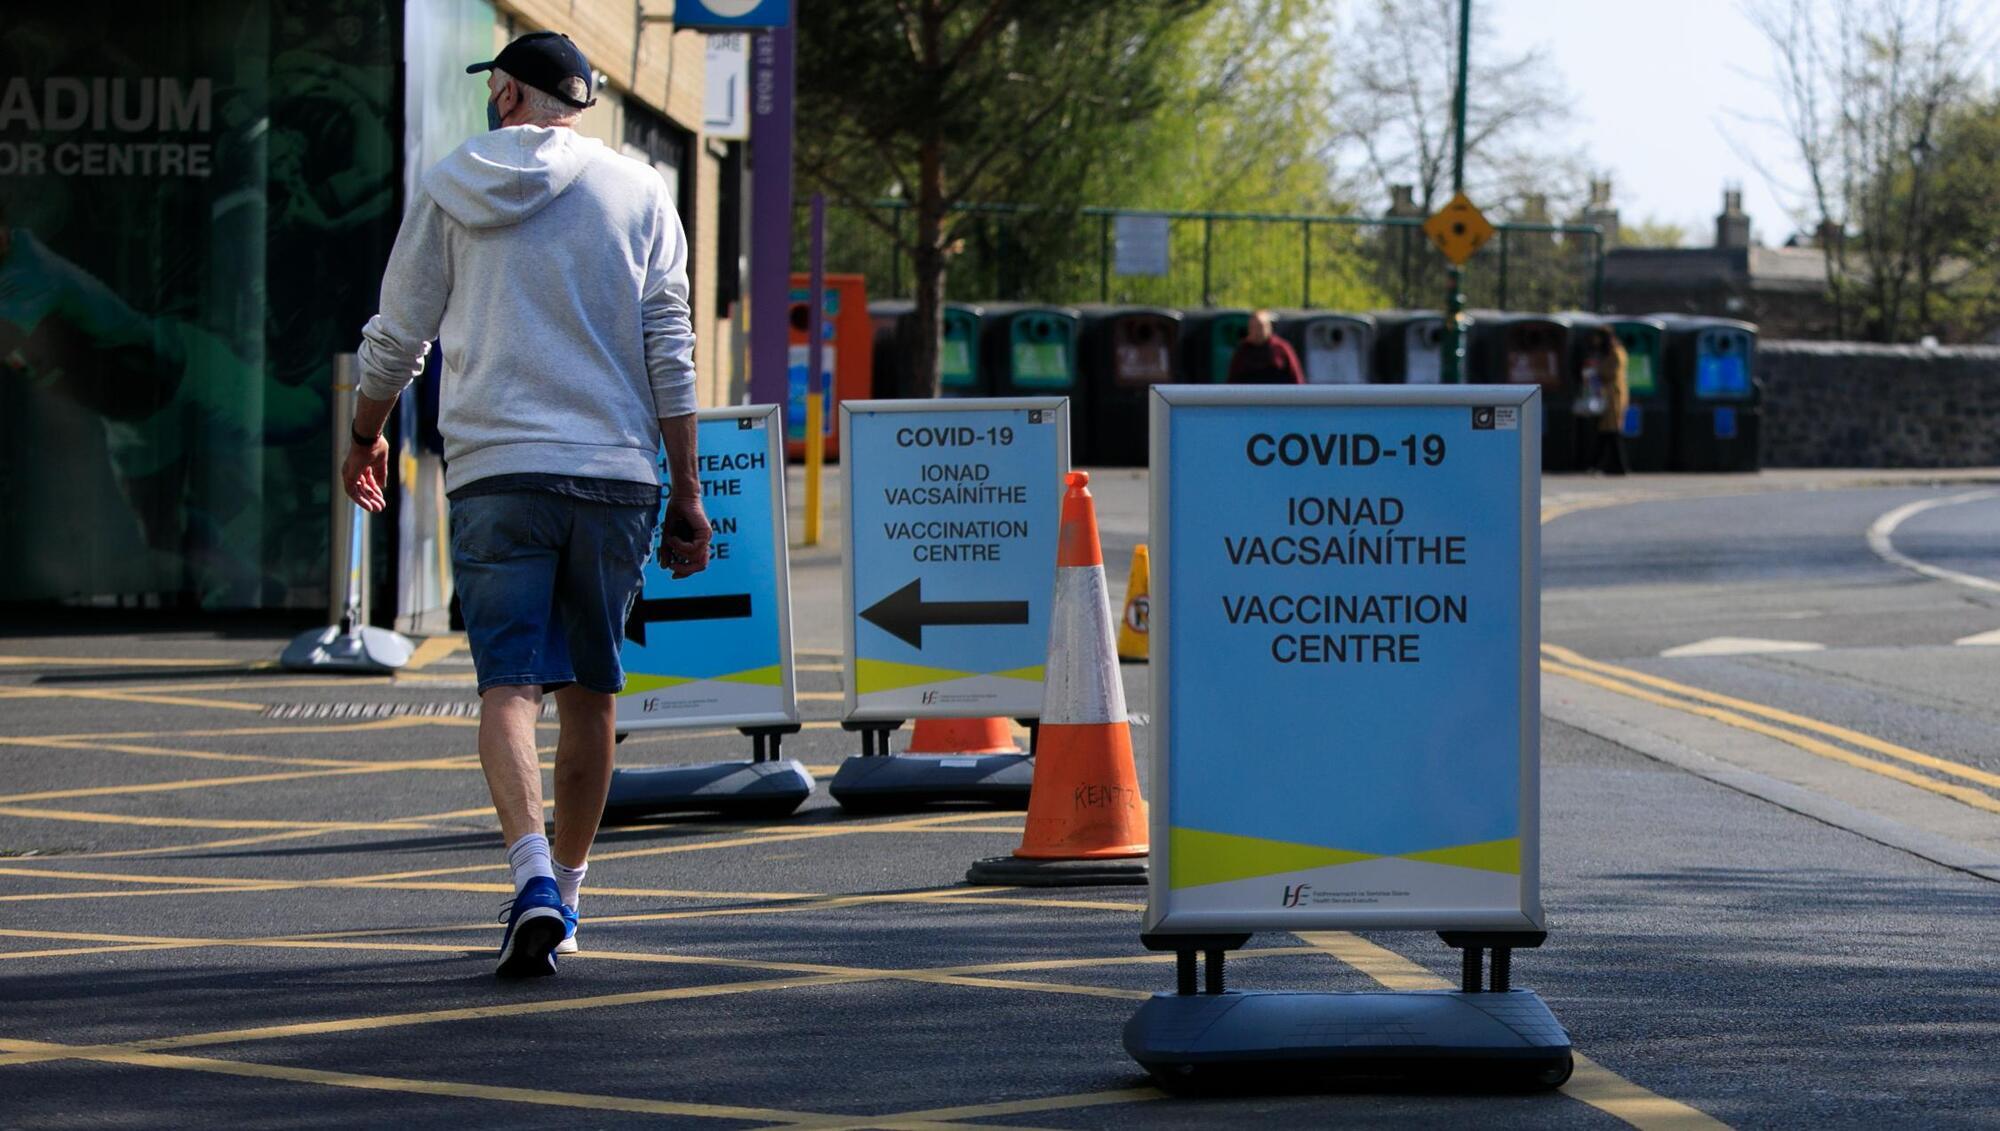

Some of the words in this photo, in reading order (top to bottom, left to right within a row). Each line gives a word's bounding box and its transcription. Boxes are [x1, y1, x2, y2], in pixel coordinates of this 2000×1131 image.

[0, 77, 212, 131] ADIUM
[0, 142, 46, 176] OR
[53, 142, 212, 177] CENTRE
[896, 426, 1014, 447] COVID-19
[1246, 432, 1446, 467] COVID-19
[698, 452, 765, 473] TEACH
[921, 464, 990, 482] IONAD
[884, 482, 1027, 506] VACSAÍNÍTHE
[1288, 497, 1404, 526] IONAD
[884, 520, 1028, 540] VACCINATION
[913, 543, 1001, 563] CENTRE
[1224, 528, 1467, 566] VACSAÍNÍTHE
[1222, 595, 1467, 625] VACCINATION
[1271, 633, 1420, 664] CENTRE
